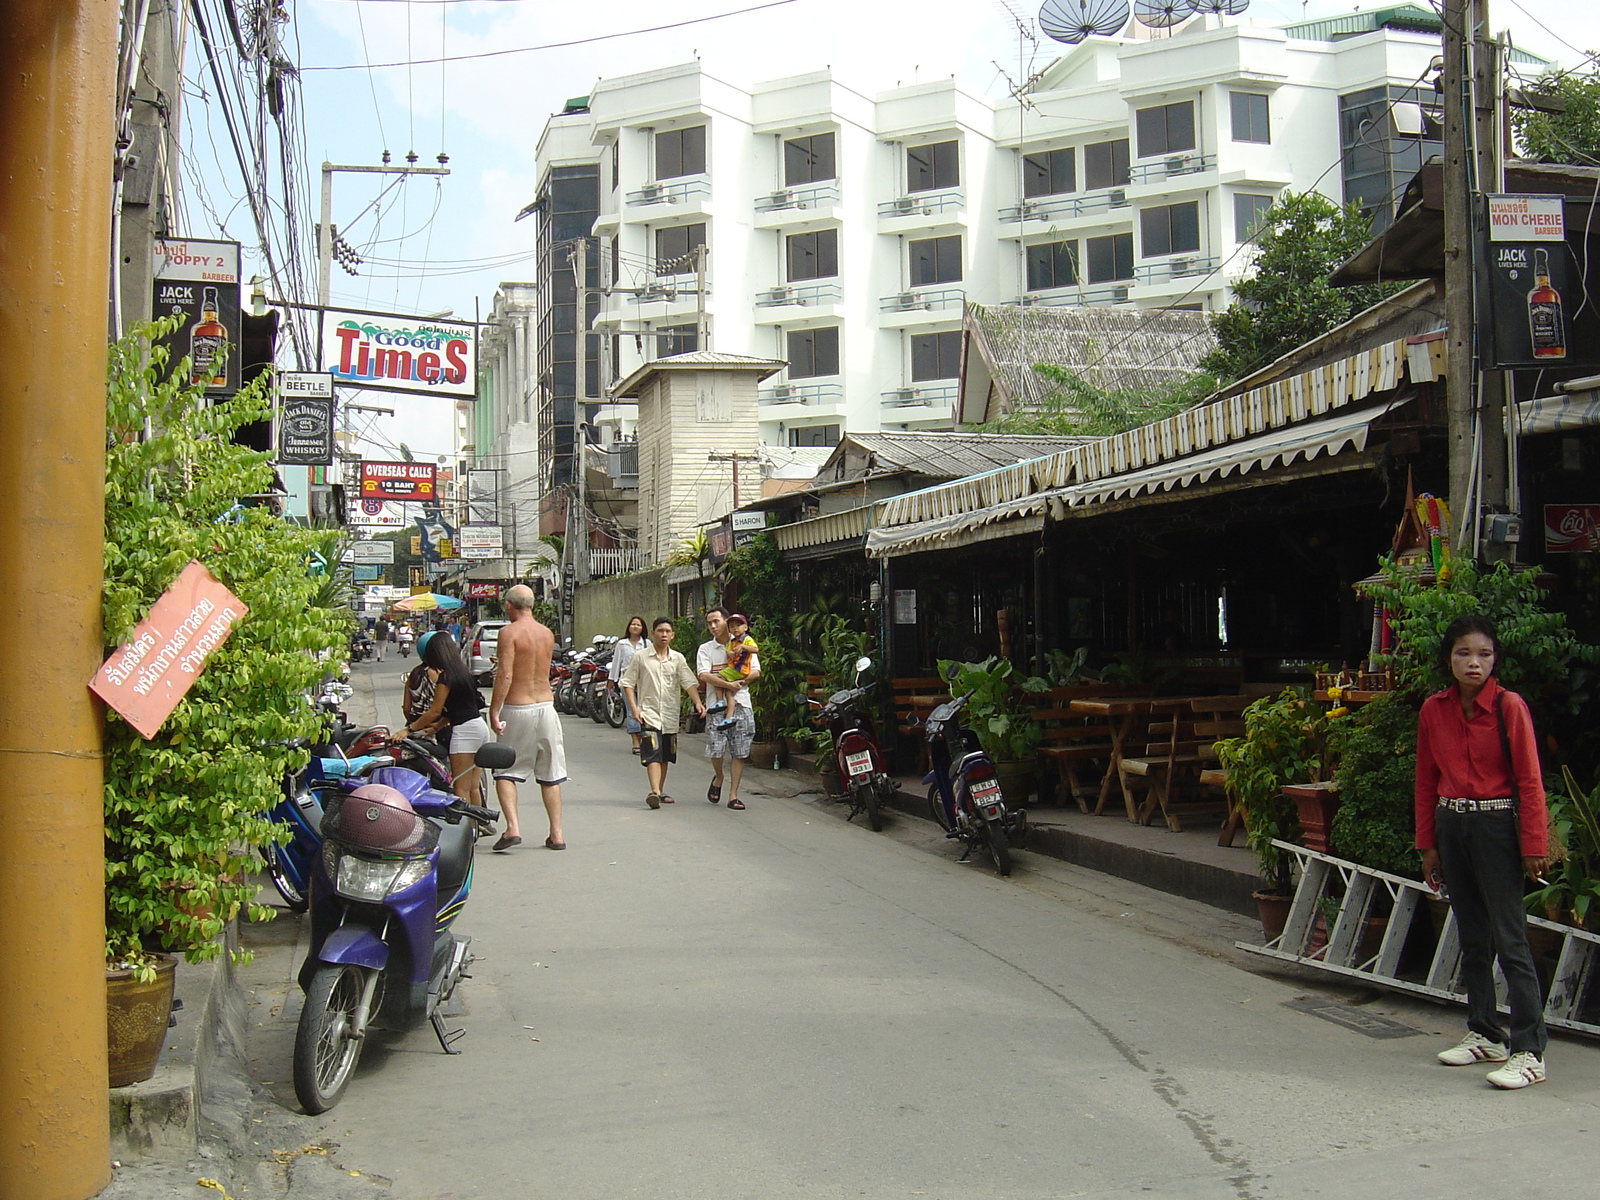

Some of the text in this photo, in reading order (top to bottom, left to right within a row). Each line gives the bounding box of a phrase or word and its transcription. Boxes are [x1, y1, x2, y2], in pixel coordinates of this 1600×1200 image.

[1492, 214, 1518, 225] MON
[1521, 214, 1562, 226] CHERIE
[1534, 227, 1563, 235] BARBEER
[166, 255, 224, 267] POPPY 2
[1498, 249, 1526, 262] JACK
[202, 272, 235, 282] BARBEER
[160, 286, 193, 298] JACK
[375, 332, 441, 350] Good
[286, 381, 325, 391] BEETLE
[285, 405, 327, 420] JACK DANIEL'S
[287, 435, 324, 446] Tennessee
[285, 446, 327, 454] WHISKEY
[366, 464, 432, 478] OVERSEAS CALLS
[735, 517, 761, 526] SHARON
[133, 597, 215, 695] พนักงานสาวสวย
[180, 607, 237, 674] จำนวนมาก
[105, 631, 156, 686] รับสมัคร
